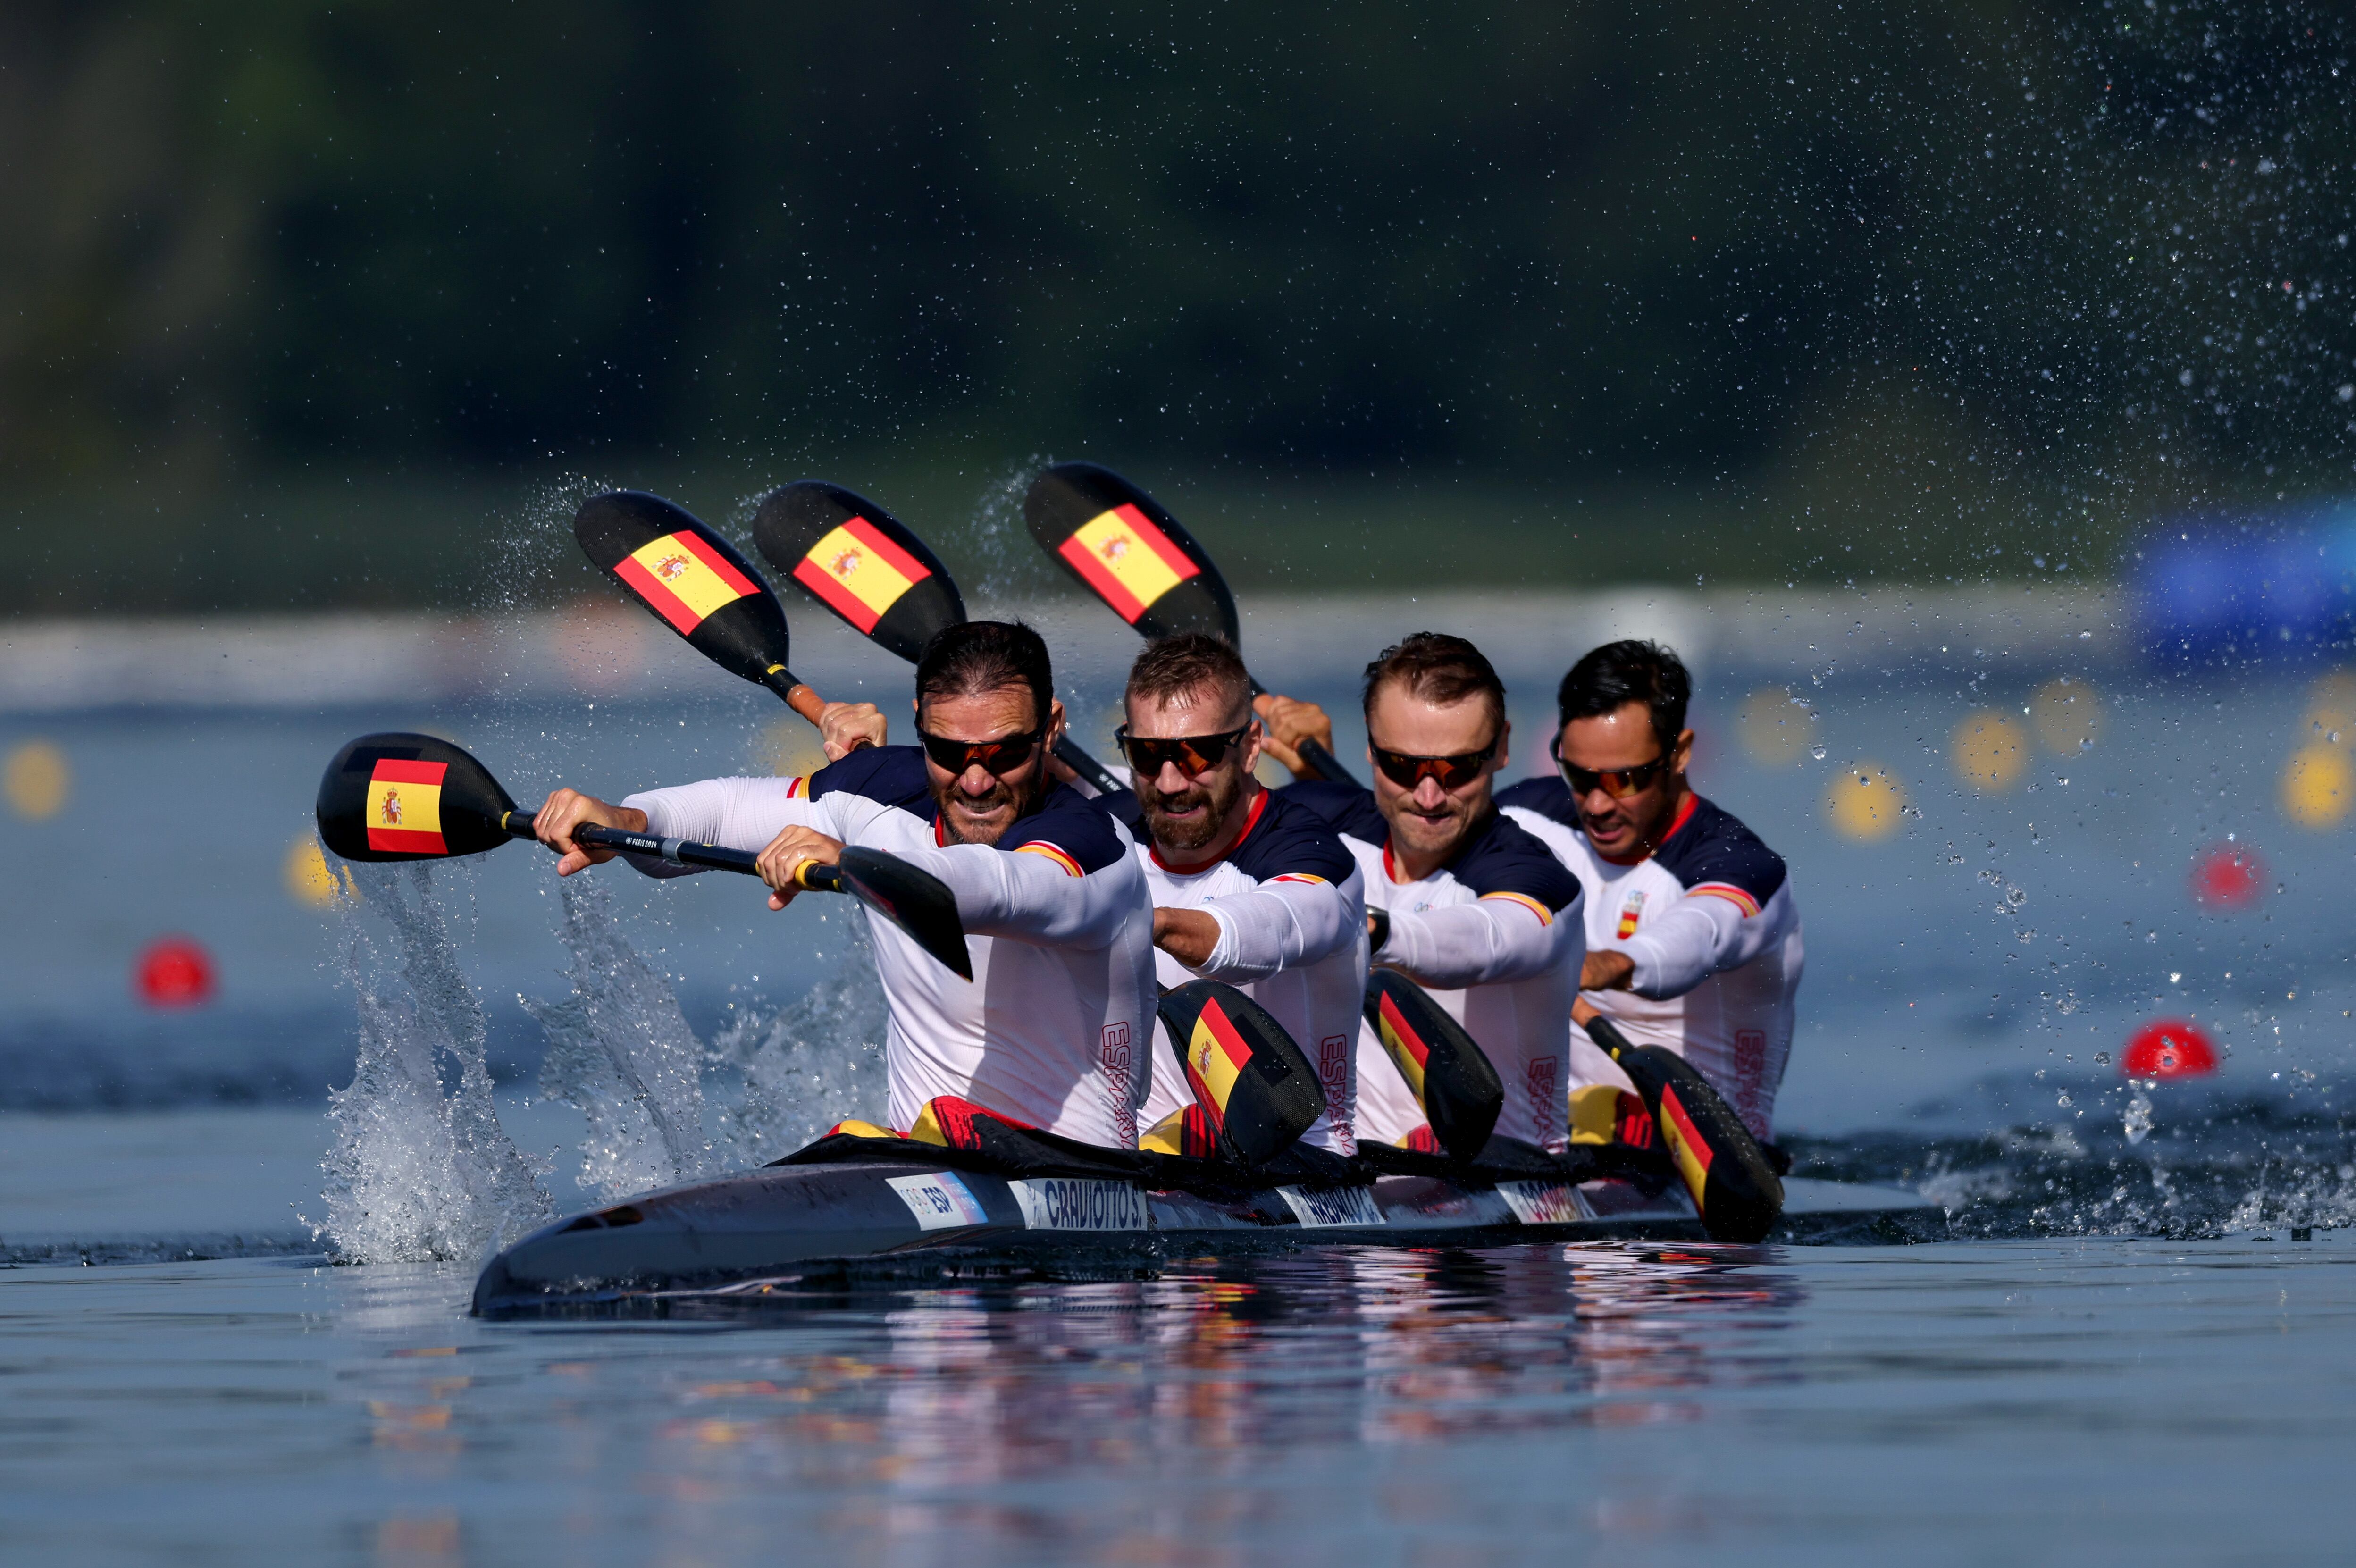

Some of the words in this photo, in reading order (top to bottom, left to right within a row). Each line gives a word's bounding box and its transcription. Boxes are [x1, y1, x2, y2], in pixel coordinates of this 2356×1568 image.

[632, 838, 645, 847] PARIS
[645, 840, 657, 848] 2024
[921, 1186, 953, 1213] ESP
